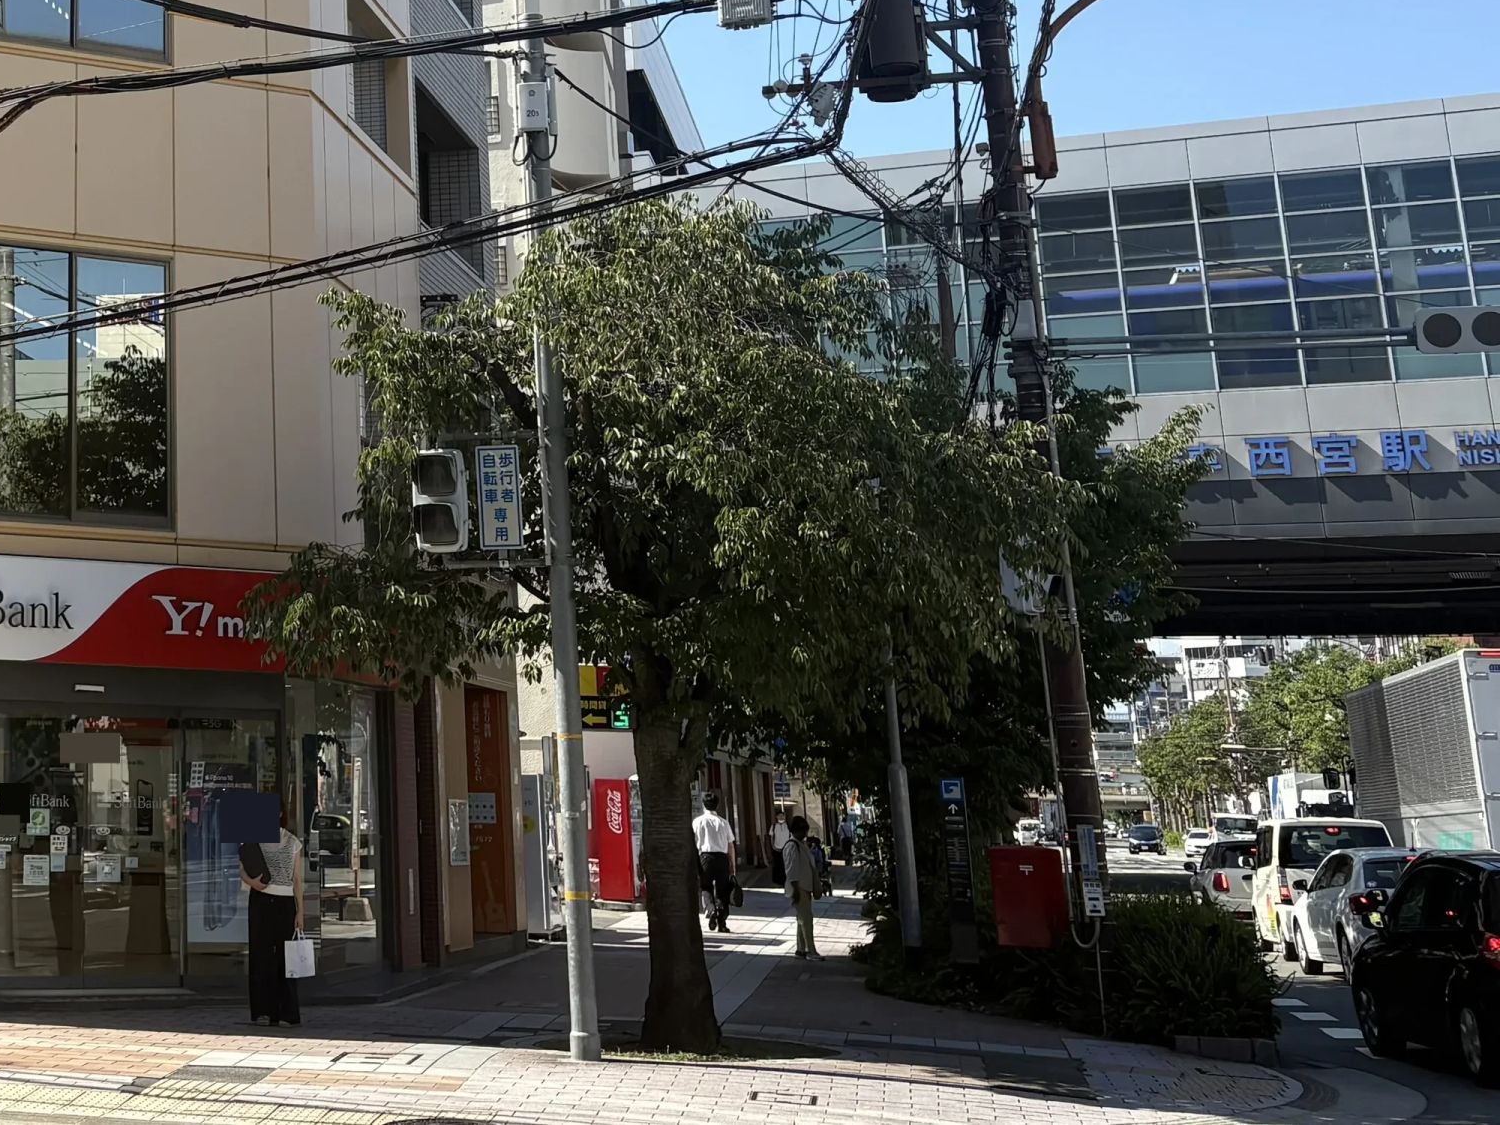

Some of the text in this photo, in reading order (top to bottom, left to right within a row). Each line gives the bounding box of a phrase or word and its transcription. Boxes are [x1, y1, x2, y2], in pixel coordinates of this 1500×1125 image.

[482, 454, 499, 504] 自転車
[498, 453, 515, 503] 歩行者
[493, 507, 509, 542] 専用
